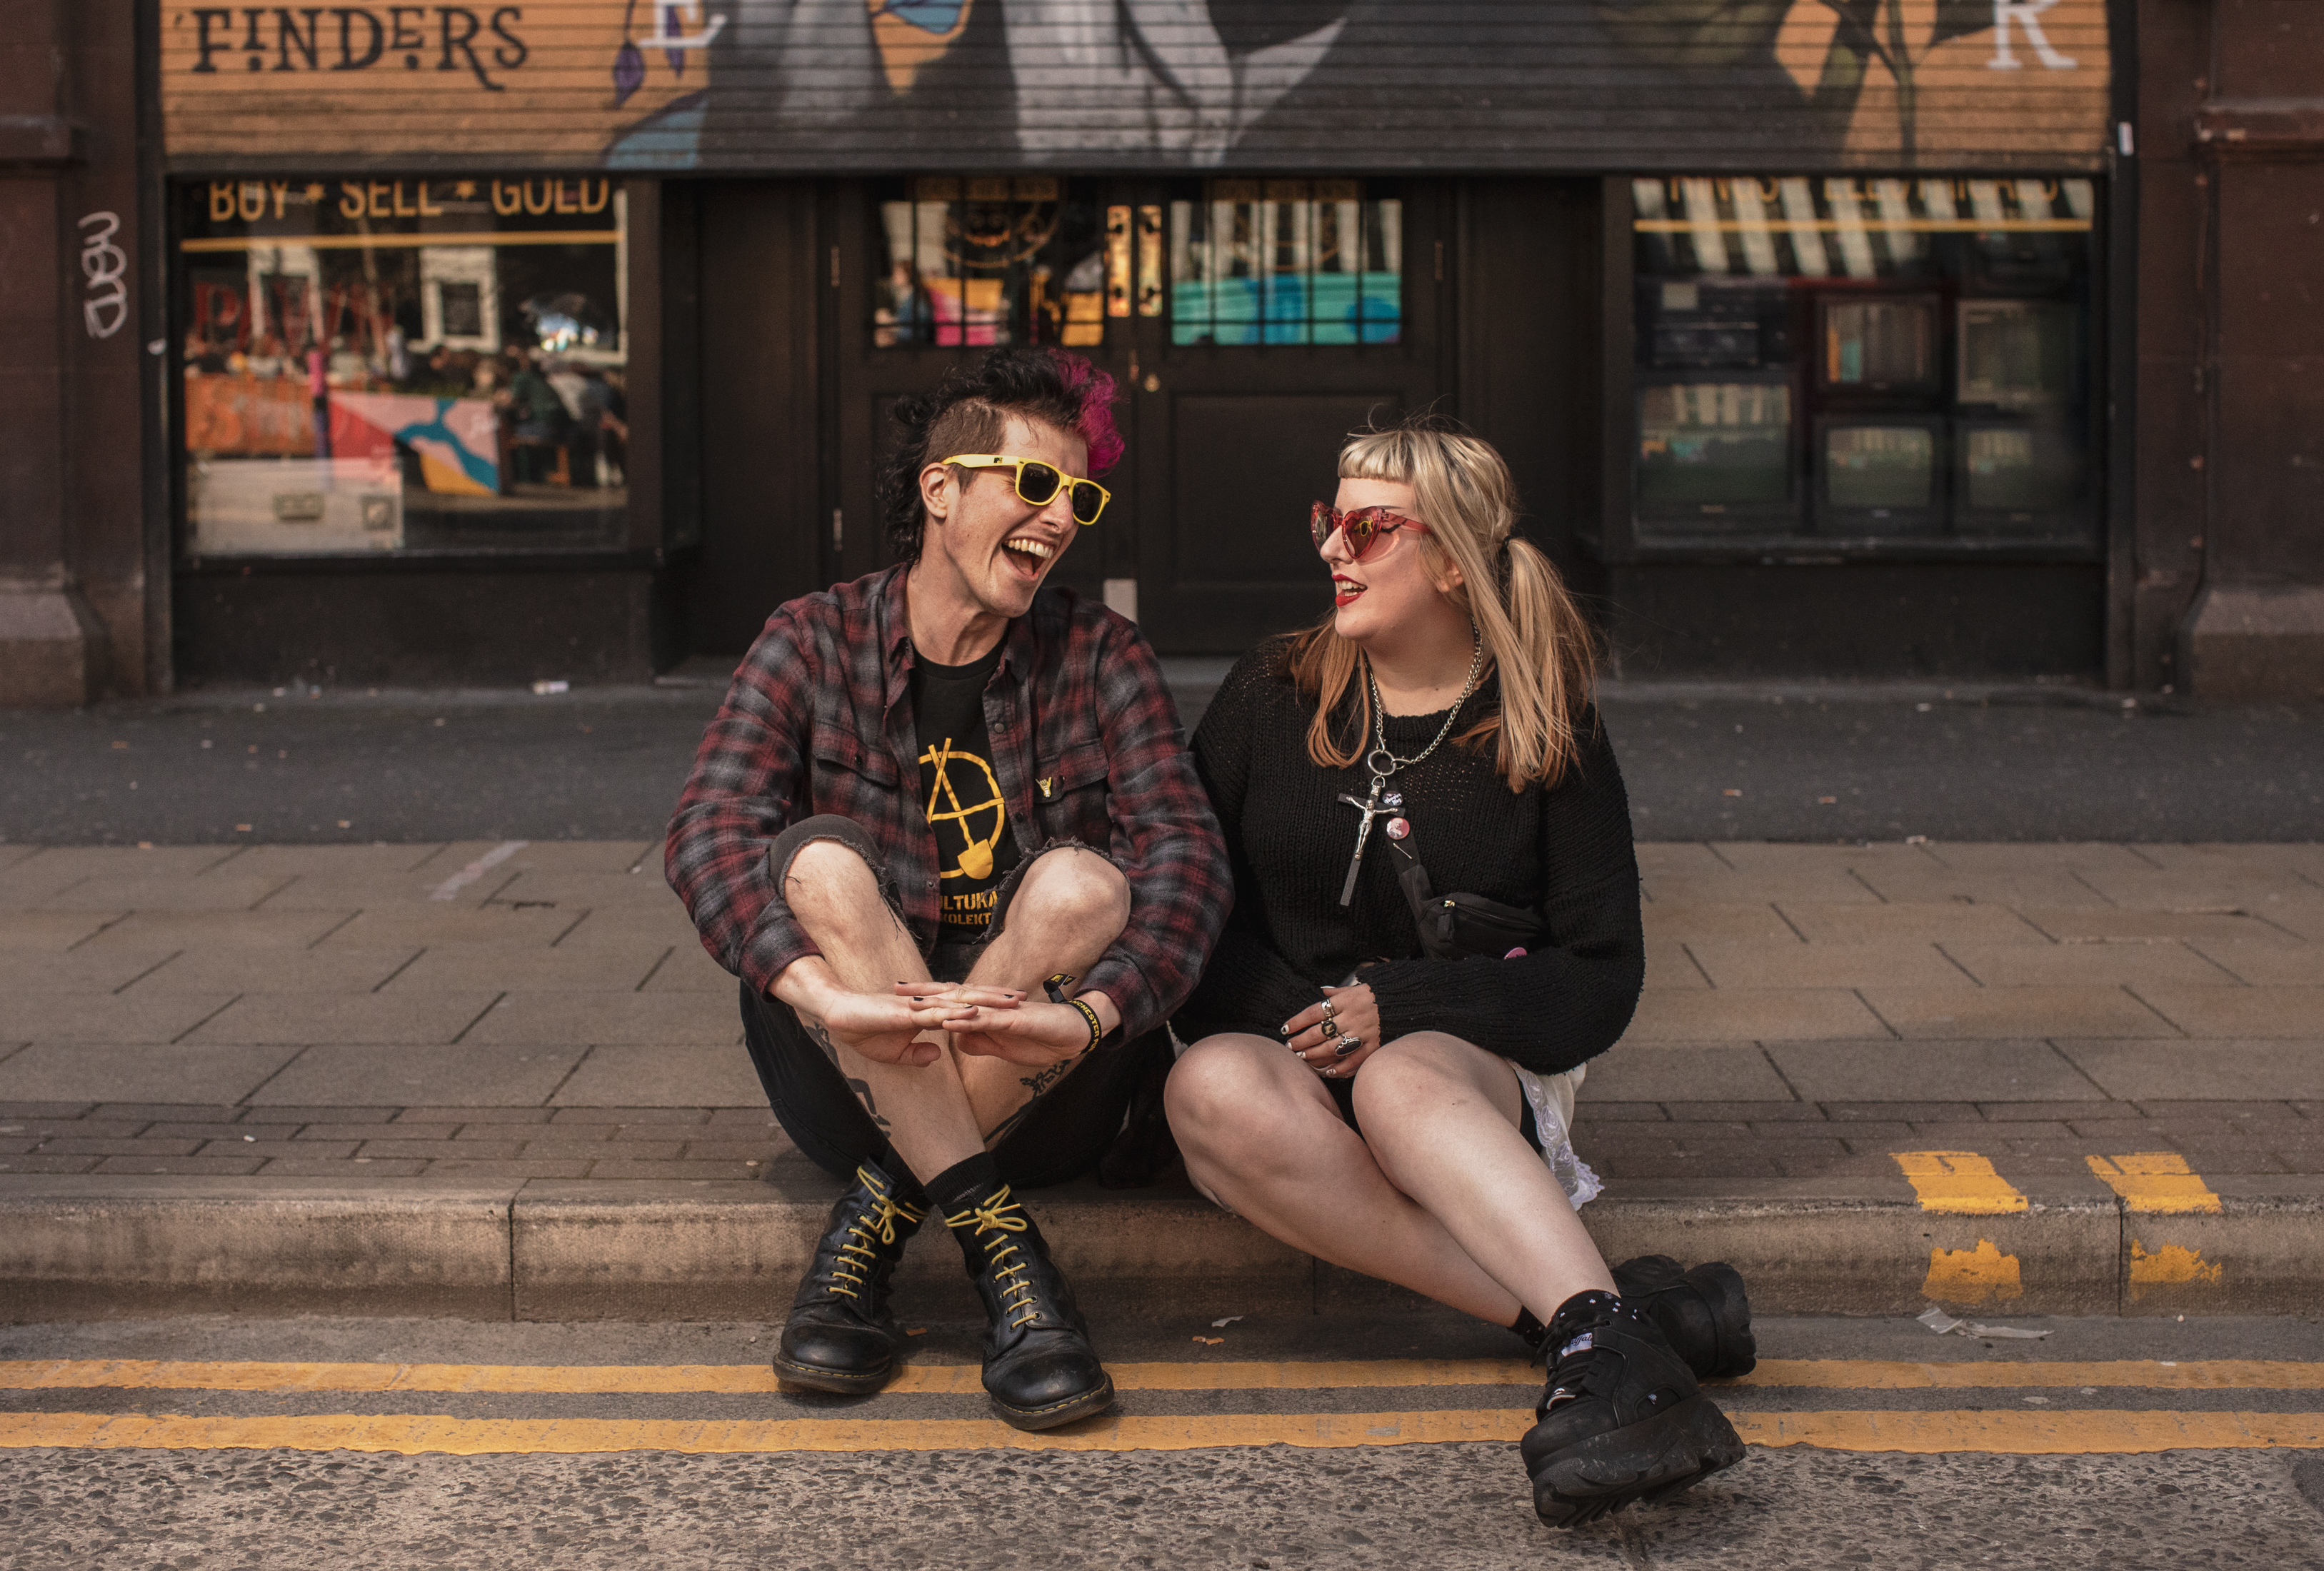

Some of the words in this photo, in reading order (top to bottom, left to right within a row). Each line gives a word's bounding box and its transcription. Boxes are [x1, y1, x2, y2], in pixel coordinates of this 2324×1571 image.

[190, 6, 527, 91] FINDERS
[209, 181, 289, 222] BUY
[339, 181, 443, 220] SELL
[491, 179, 609, 216] GOLD
